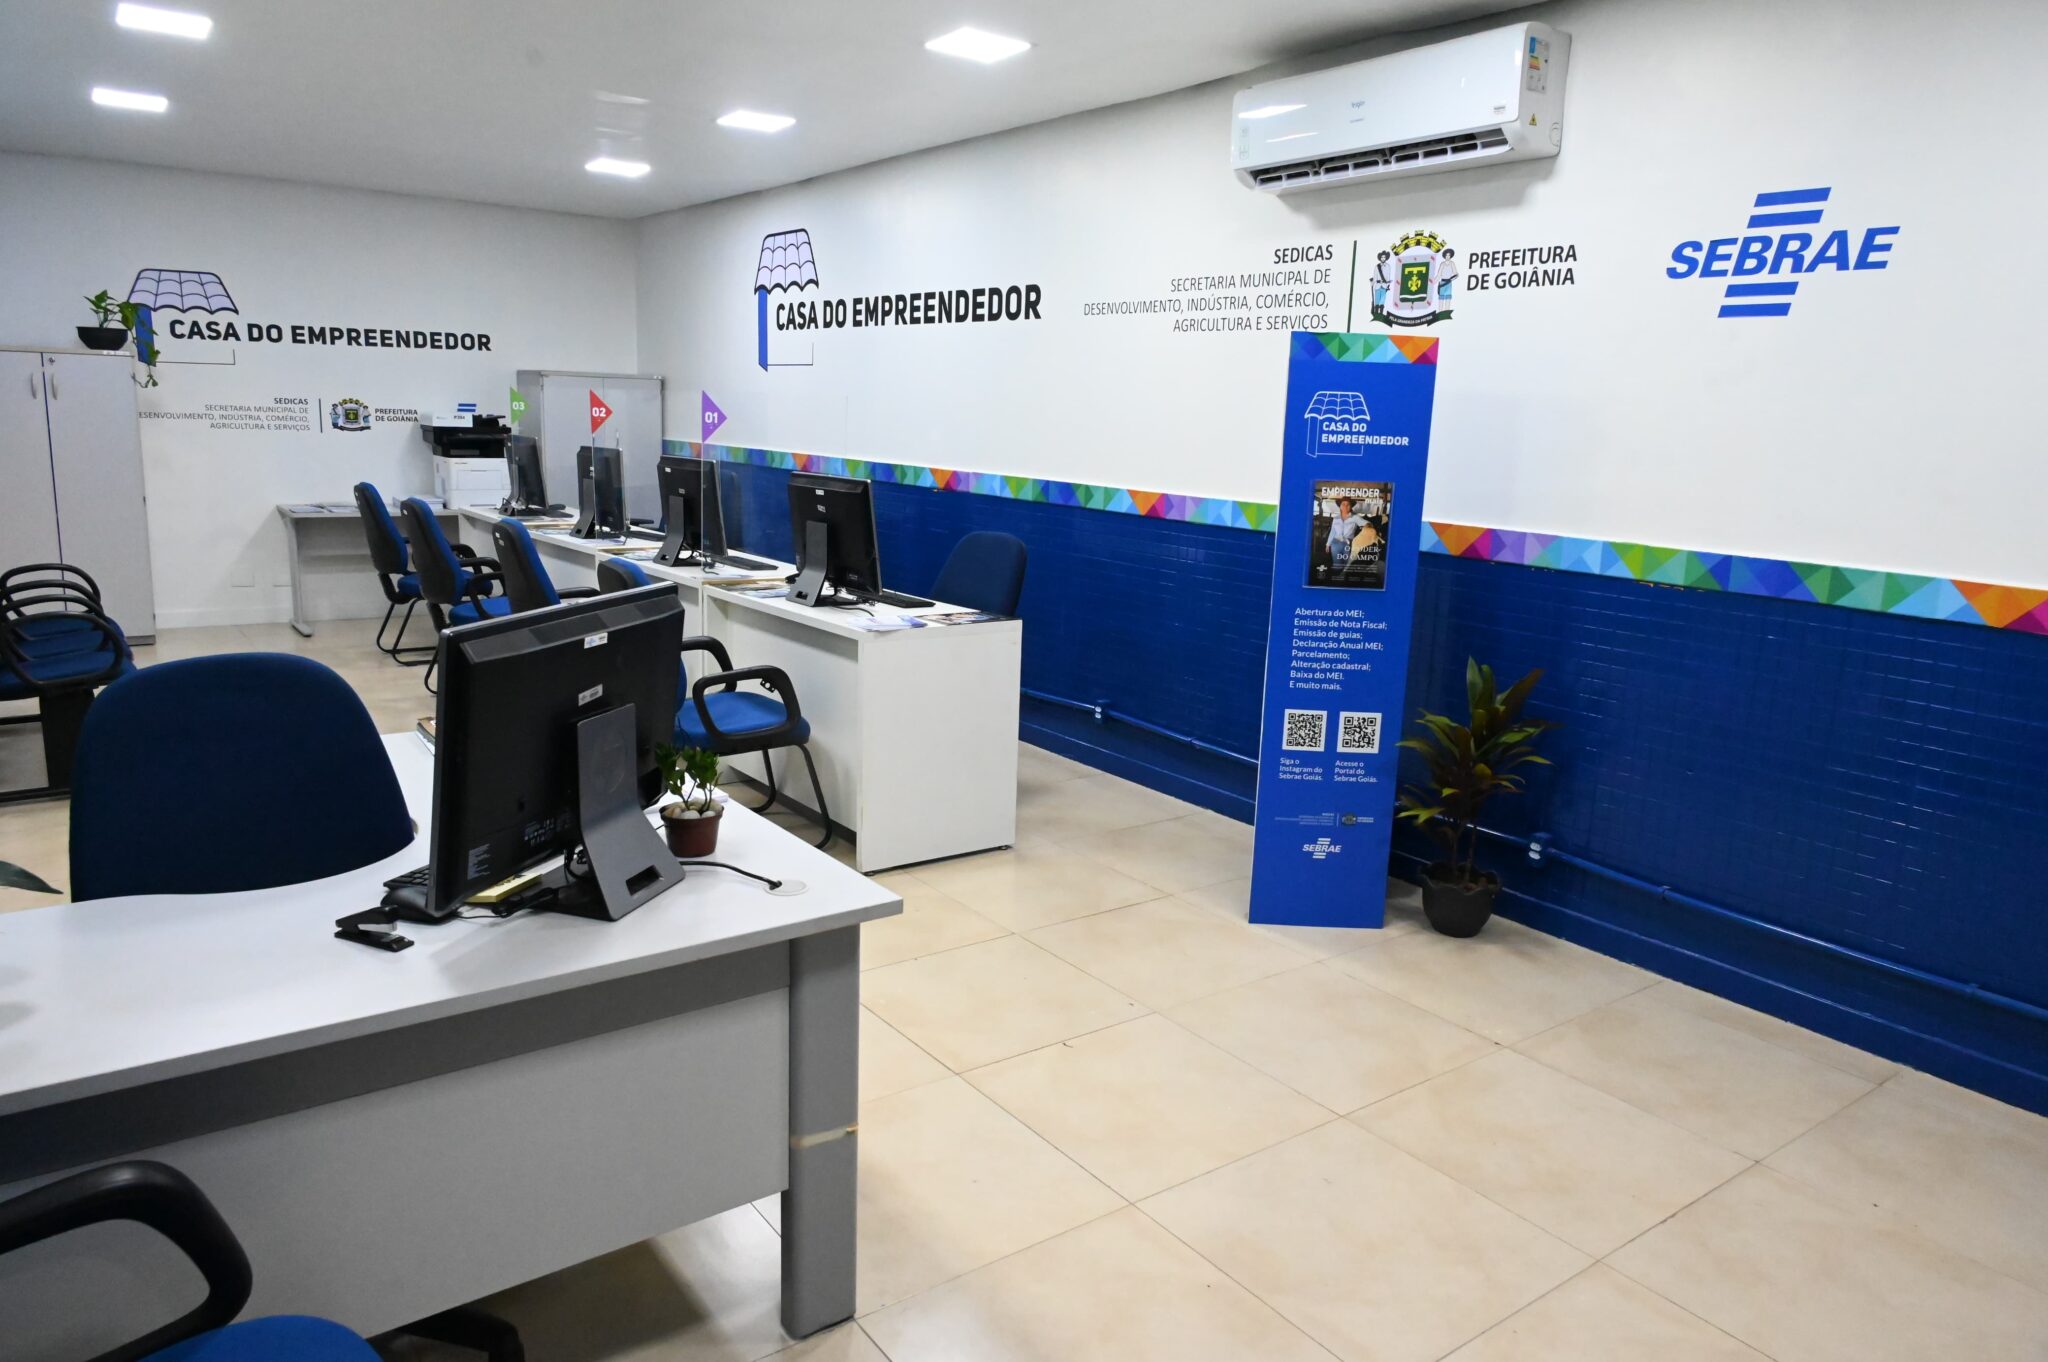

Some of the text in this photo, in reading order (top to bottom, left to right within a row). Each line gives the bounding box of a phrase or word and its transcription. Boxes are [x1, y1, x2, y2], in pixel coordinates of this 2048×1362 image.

[1273, 244, 1333, 264] SEDICAS
[1468, 244, 1577, 269] PREFEITURA
[1666, 225, 1901, 280] SEBRAE
[1170, 268, 1332, 293] SECRETARIA MUNICIPAL DE
[1466, 266, 1575, 291] DE GOIÂNIA
[776, 284, 1042, 331] CASA DO EMPREENDEDOR
[1083, 289, 1329, 316] DESENVOLVIMENTO, INDÚSTRIA, COMÉRCIO,
[1173, 314, 1328, 333] AGRICULTURA E SERVIÇOS
[169, 319, 492, 351] CASA DO EMPREENDEDOR
[273, 397, 309, 406] SEDICAS
[512, 401, 525, 411] 03
[204, 404, 252, 412] SECRETARIA
[254, 406, 298, 414] MUNICIPAL
[375, 408, 418, 416] PREFEITURA
[592, 407, 607, 417] 02
[138, 411, 217, 421] ESENVOLVIMENTO,
[386, 414, 419, 423] GOIÂNIA
[704, 411, 718, 424] 01
[273, 424, 311, 432] SERVIÇOS
[1323, 422, 1367, 432] CASA DO
[1321, 433, 1409, 446] EMPREENDEDOR
[1321, 487, 1380, 498] EMPREENDER
[1295, 608, 1365, 618] Abertura do MEI;
[1294, 618, 1388, 630] Emissão de Nota Fiscal;
[1293, 628, 1363, 640] Emissão de guias;
[1292, 639, 1384, 651] Declaração Anual MEI;
[1291, 649, 1350, 660] Parcelamento;
[1290, 660, 1371, 671] Alteração cadastral;
[1290, 670, 1344, 680] Baixa do MEI.
[1296, 681, 1320, 689] muito
[1280, 757, 1294, 765] Siga
[1279, 765, 1313, 773] Instagram
[1334, 767, 1365, 775] Portal do
[1302, 844, 1342, 853] SEBRAE
